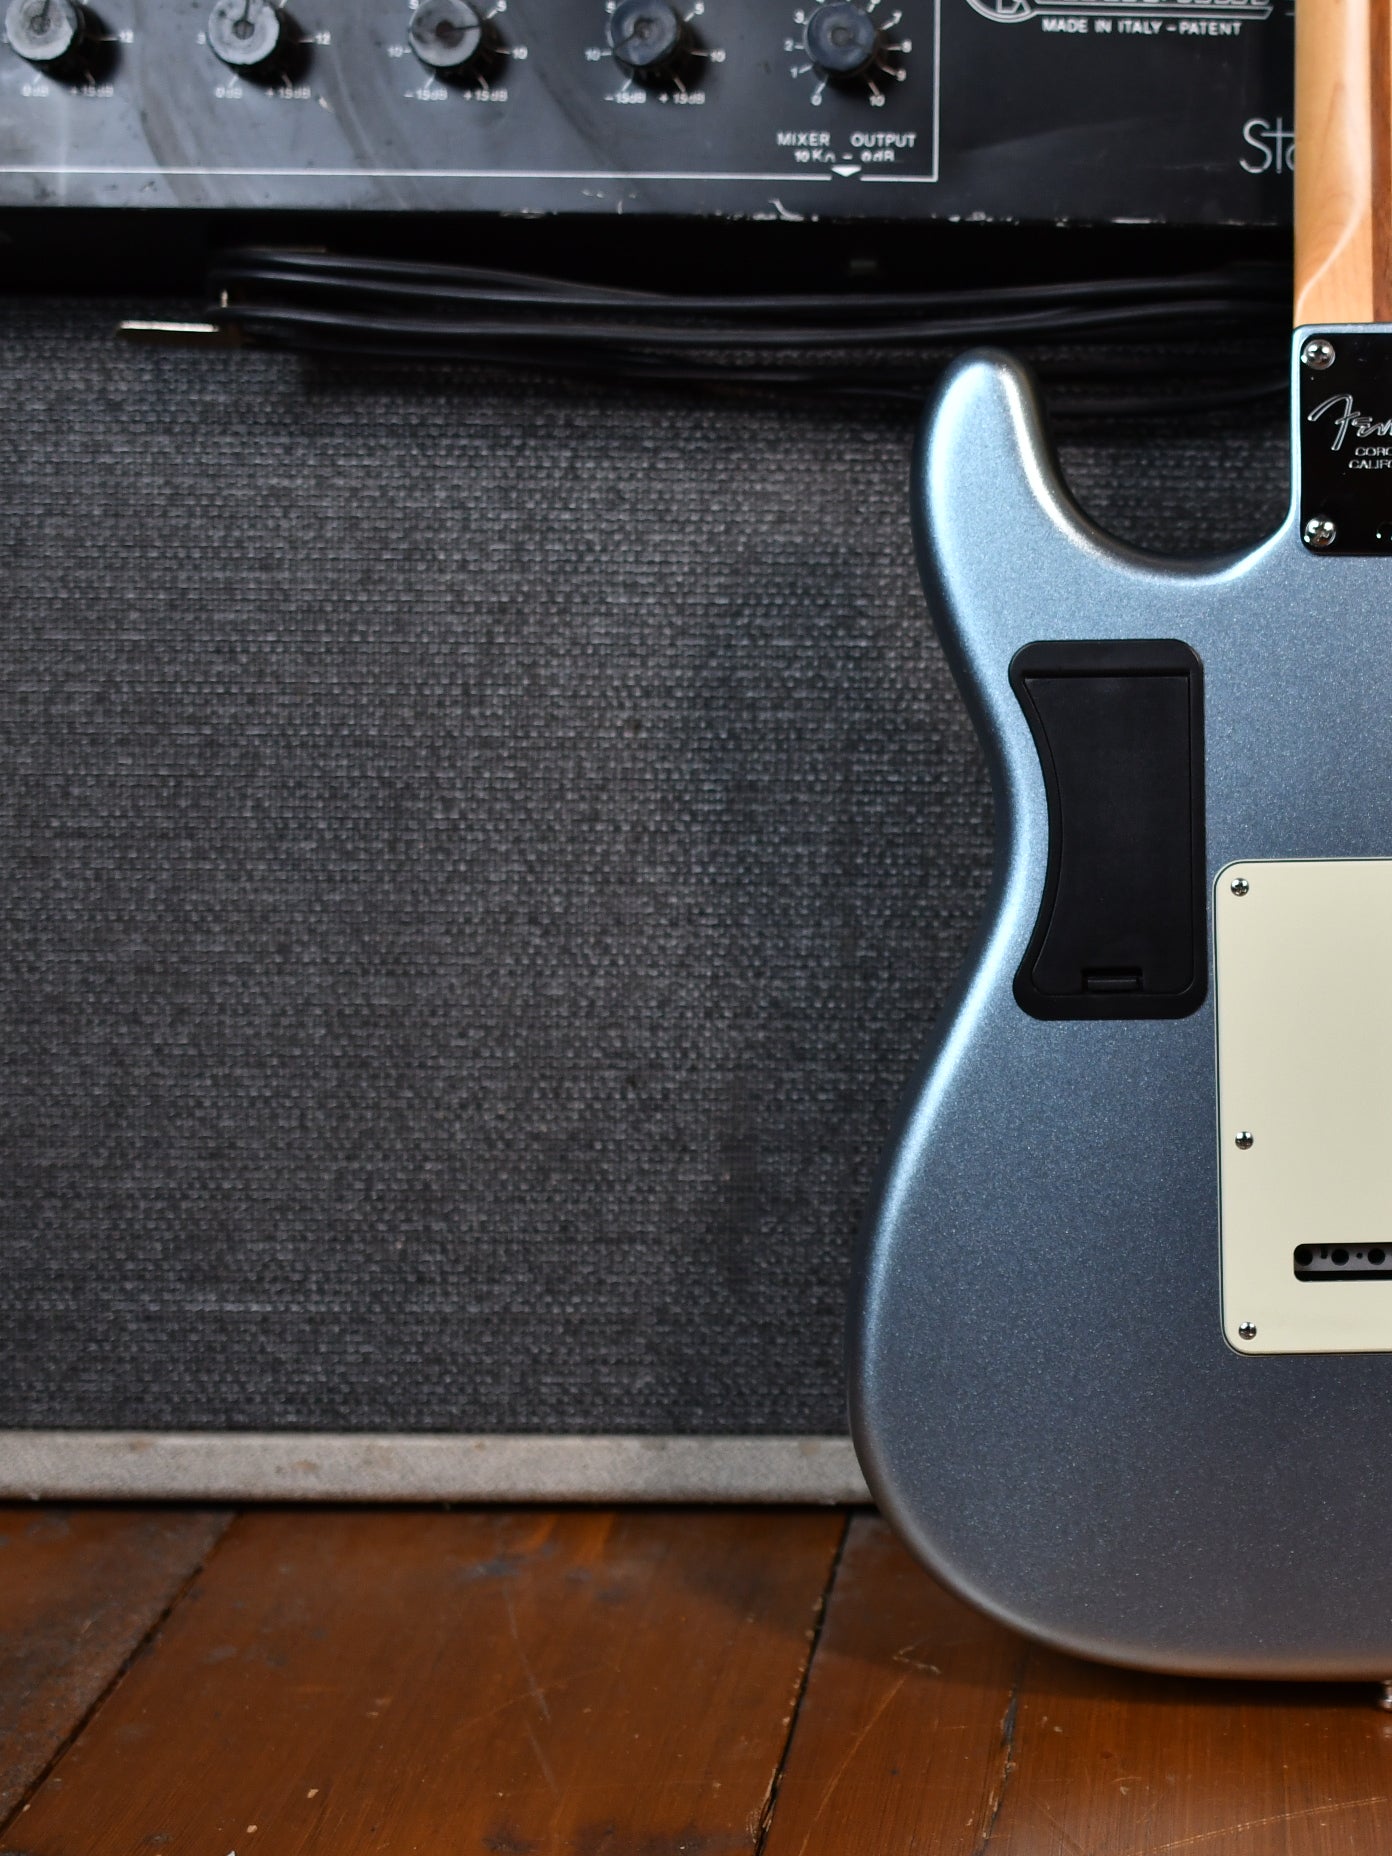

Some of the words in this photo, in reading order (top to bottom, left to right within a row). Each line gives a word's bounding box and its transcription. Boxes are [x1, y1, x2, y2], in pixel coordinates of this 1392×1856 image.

[1042, 16, 1088, 33] MADE
[1094, 18, 1112, 33] IN
[1117, 18, 1162, 34] ITALY
[1179, 20, 1241, 36] PATENT
[784, 38, 794, 52] 2
[776, 132, 831, 147] MIXER
[851, 132, 917, 148] OUTPUT
